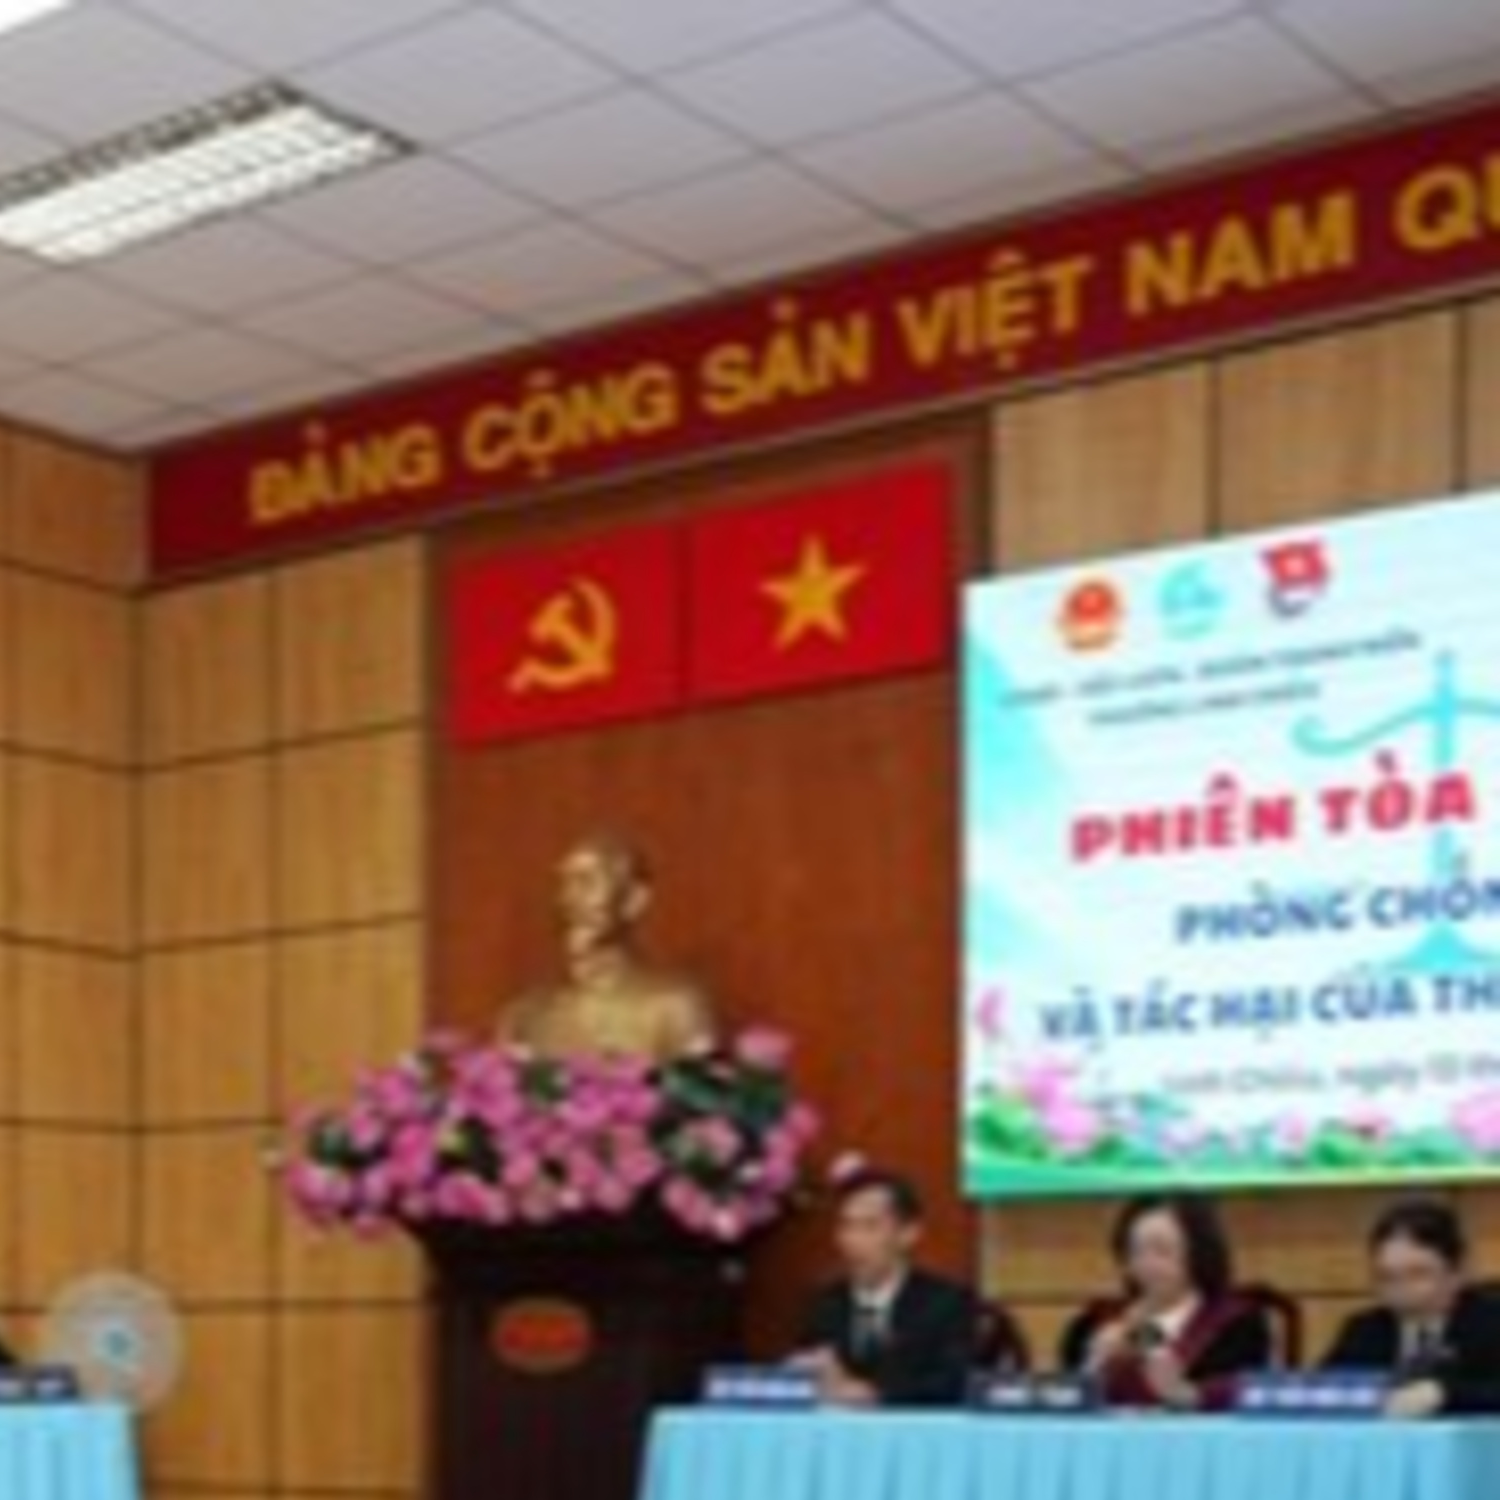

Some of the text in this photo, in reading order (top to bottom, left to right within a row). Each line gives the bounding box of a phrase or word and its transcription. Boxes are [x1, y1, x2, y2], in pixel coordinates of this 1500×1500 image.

[250, 421, 441, 522] ĐẢNG
[463, 366, 679, 481] CỘNG
[702, 301, 871, 413] SẢN
[897, 249, 1096, 370] VIỆT
[1125, 189, 1354, 316] NAM
[1069, 748, 1476, 863] PHIÊN TÒA
[1175, 878, 1354, 944] PHÒNG
[1113, 976, 1199, 1036] TÁC
[1209, 985, 1298, 1043] HẠI
